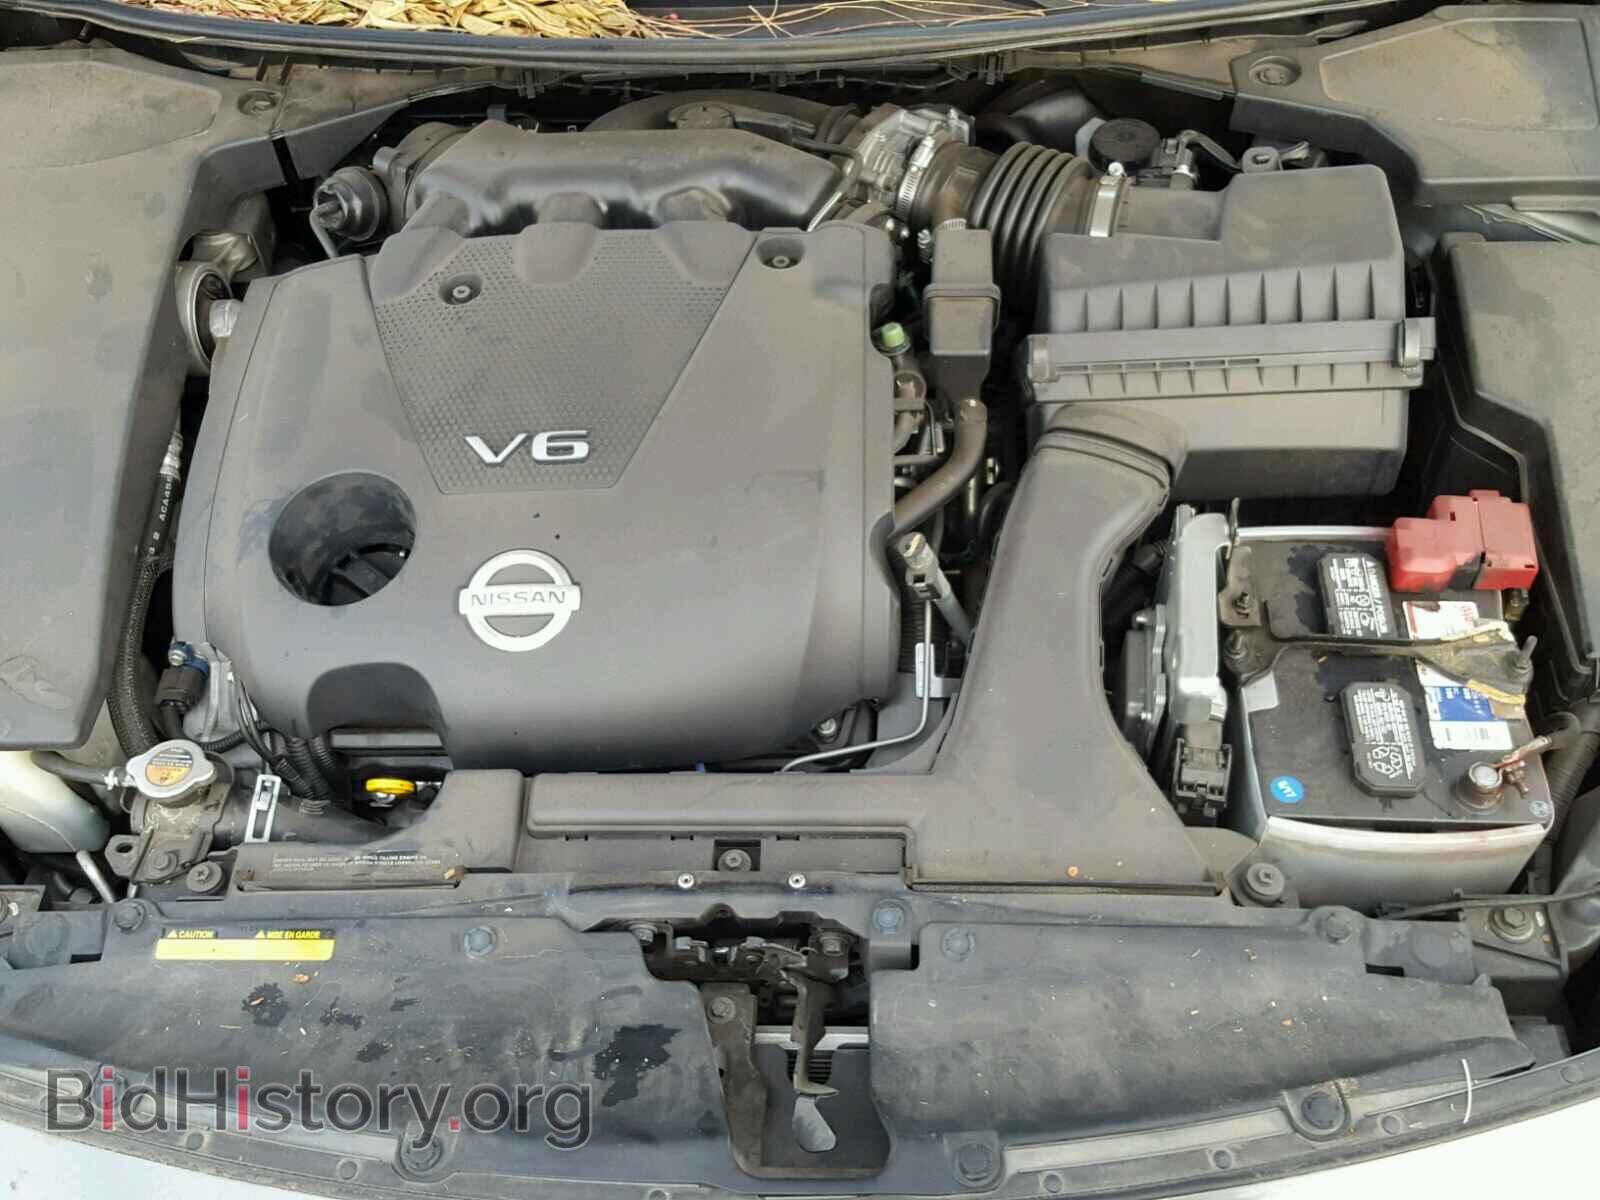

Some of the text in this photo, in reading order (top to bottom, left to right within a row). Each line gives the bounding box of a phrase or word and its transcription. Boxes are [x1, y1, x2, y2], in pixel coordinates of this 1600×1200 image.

[464, 430, 590, 463] V6
[471, 590, 567, 607] NISSAN
[178, 930, 214, 939] CAUTION
[296, 930, 321, 939] GARDE
